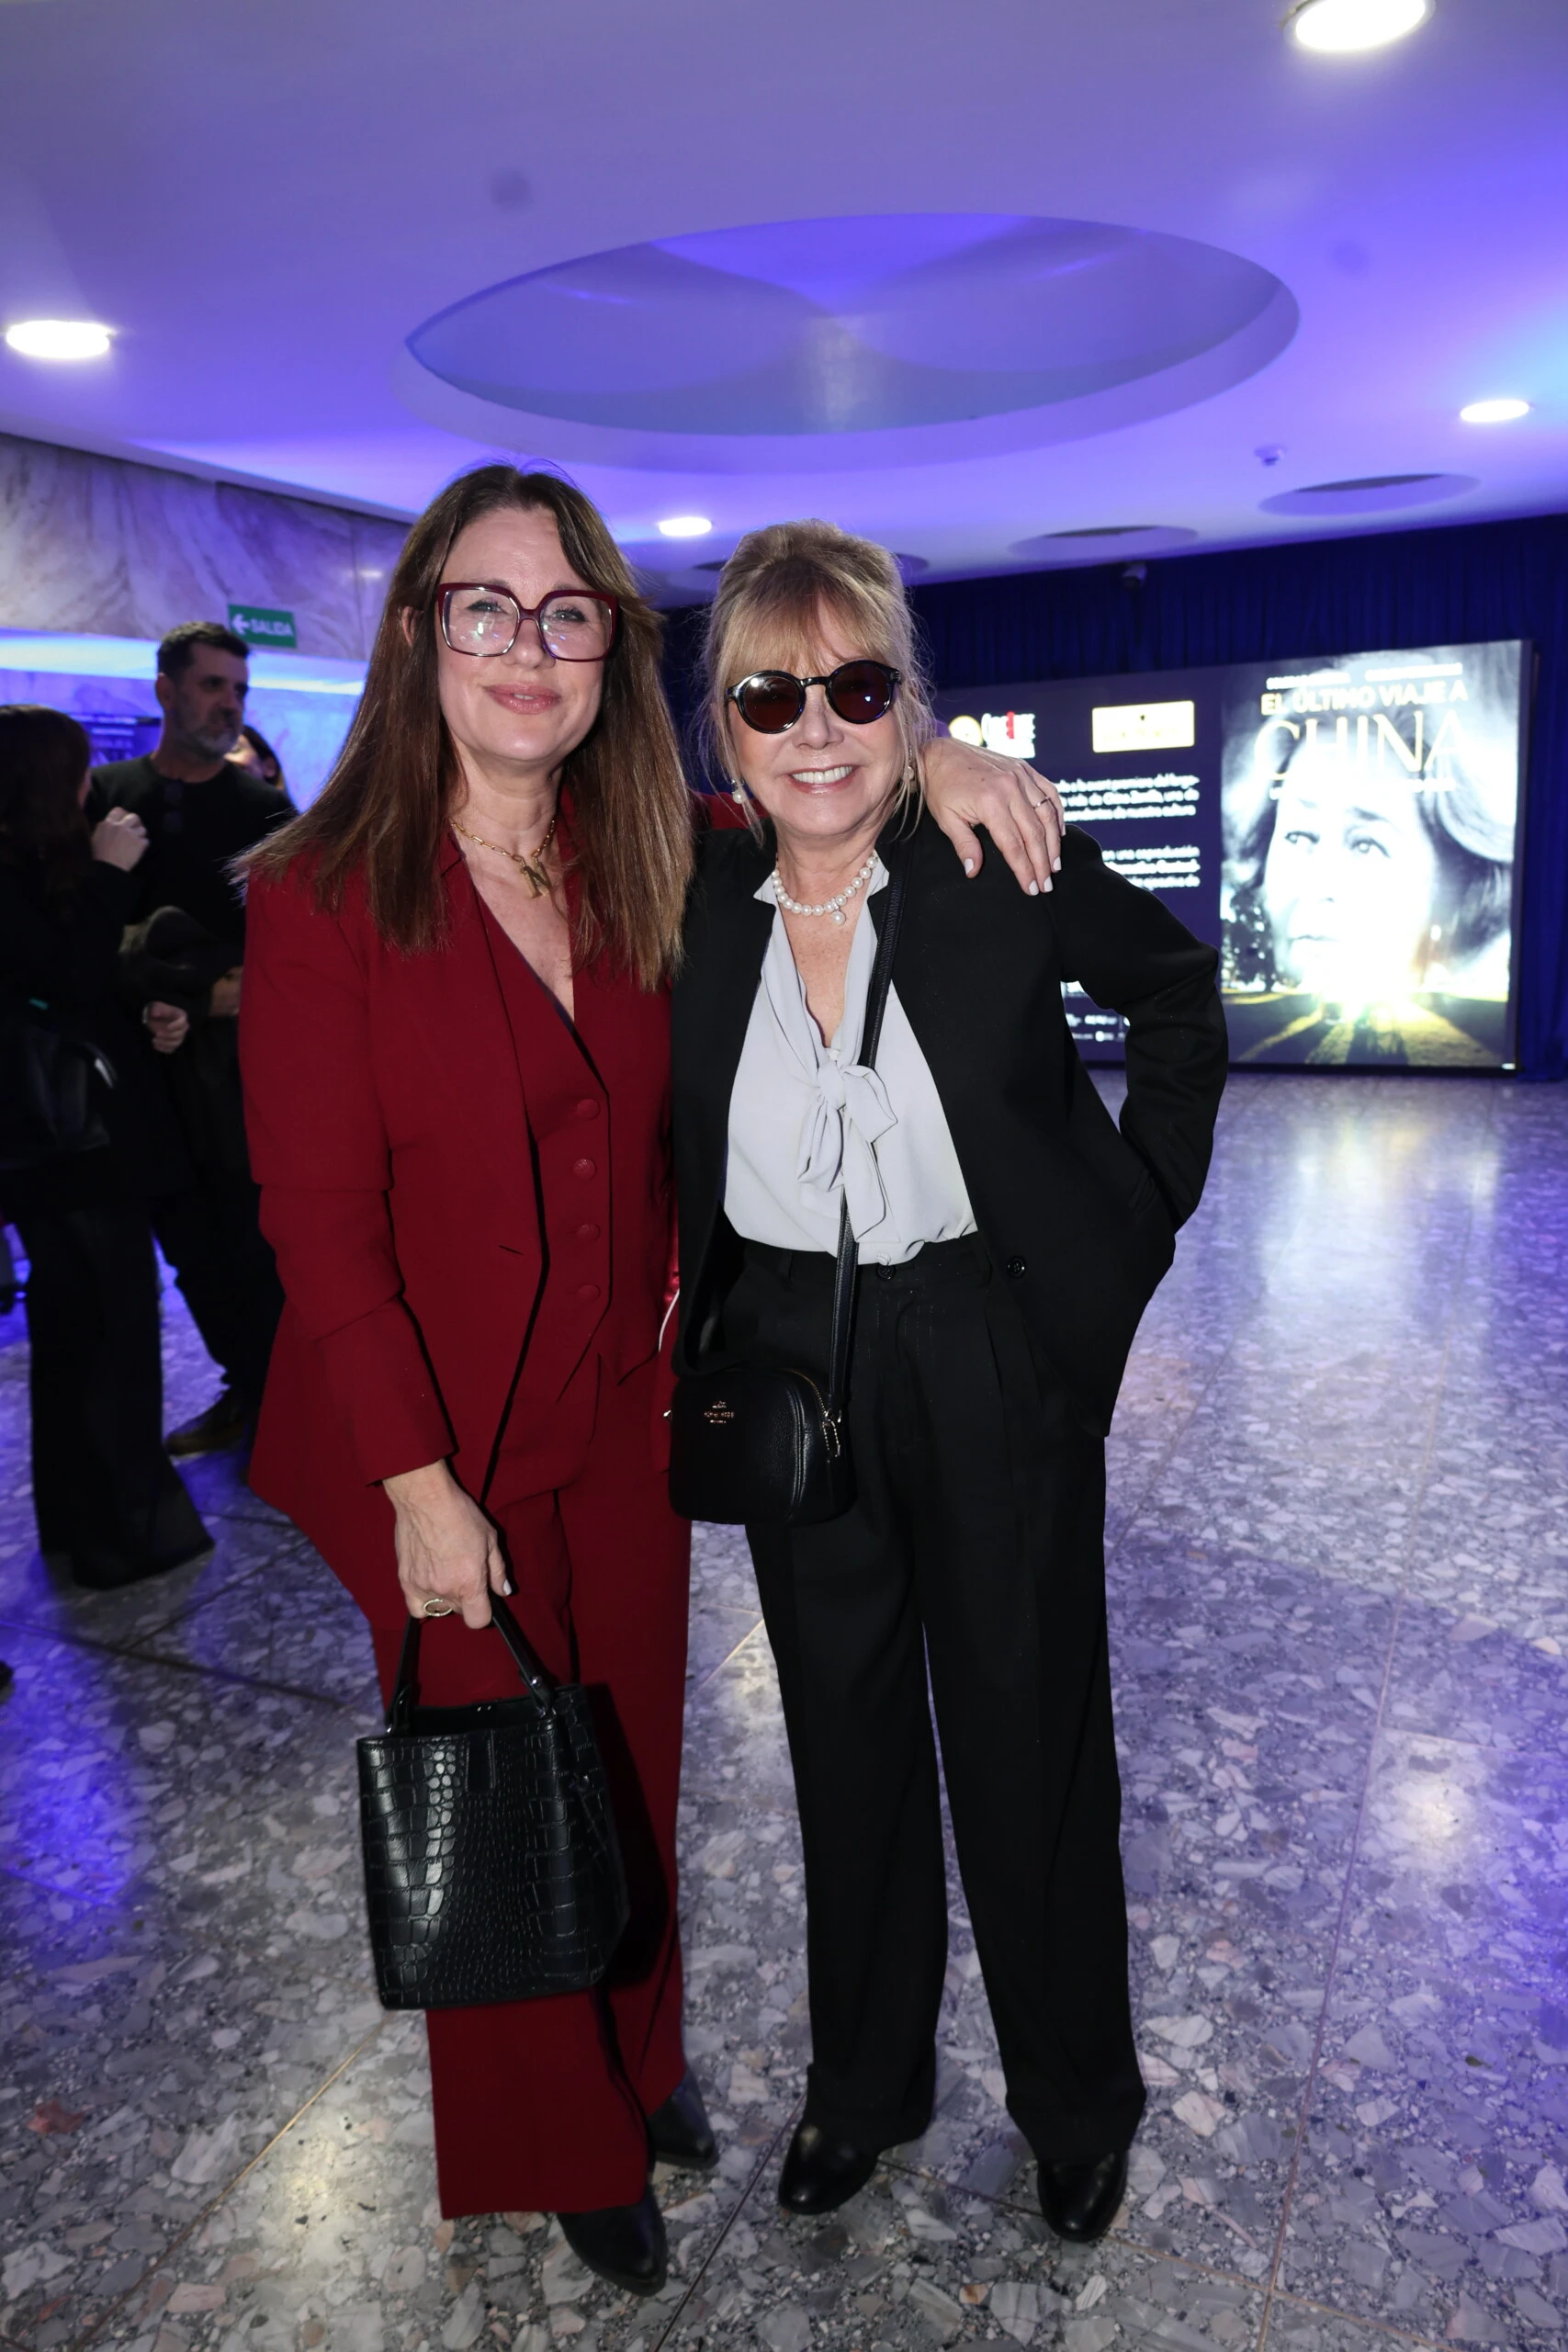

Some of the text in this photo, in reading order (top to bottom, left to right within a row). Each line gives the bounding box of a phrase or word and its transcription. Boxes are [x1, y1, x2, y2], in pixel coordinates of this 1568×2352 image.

[249, 617, 294, 637] SALIDA
[1261, 693, 1287, 716] EL
[1292, 684, 1377, 714] ÚLTIMO
[1379, 680, 1448, 707] VIAJE
[1449, 679, 1470, 703] A
[1254, 708, 1474, 781] CHINA
